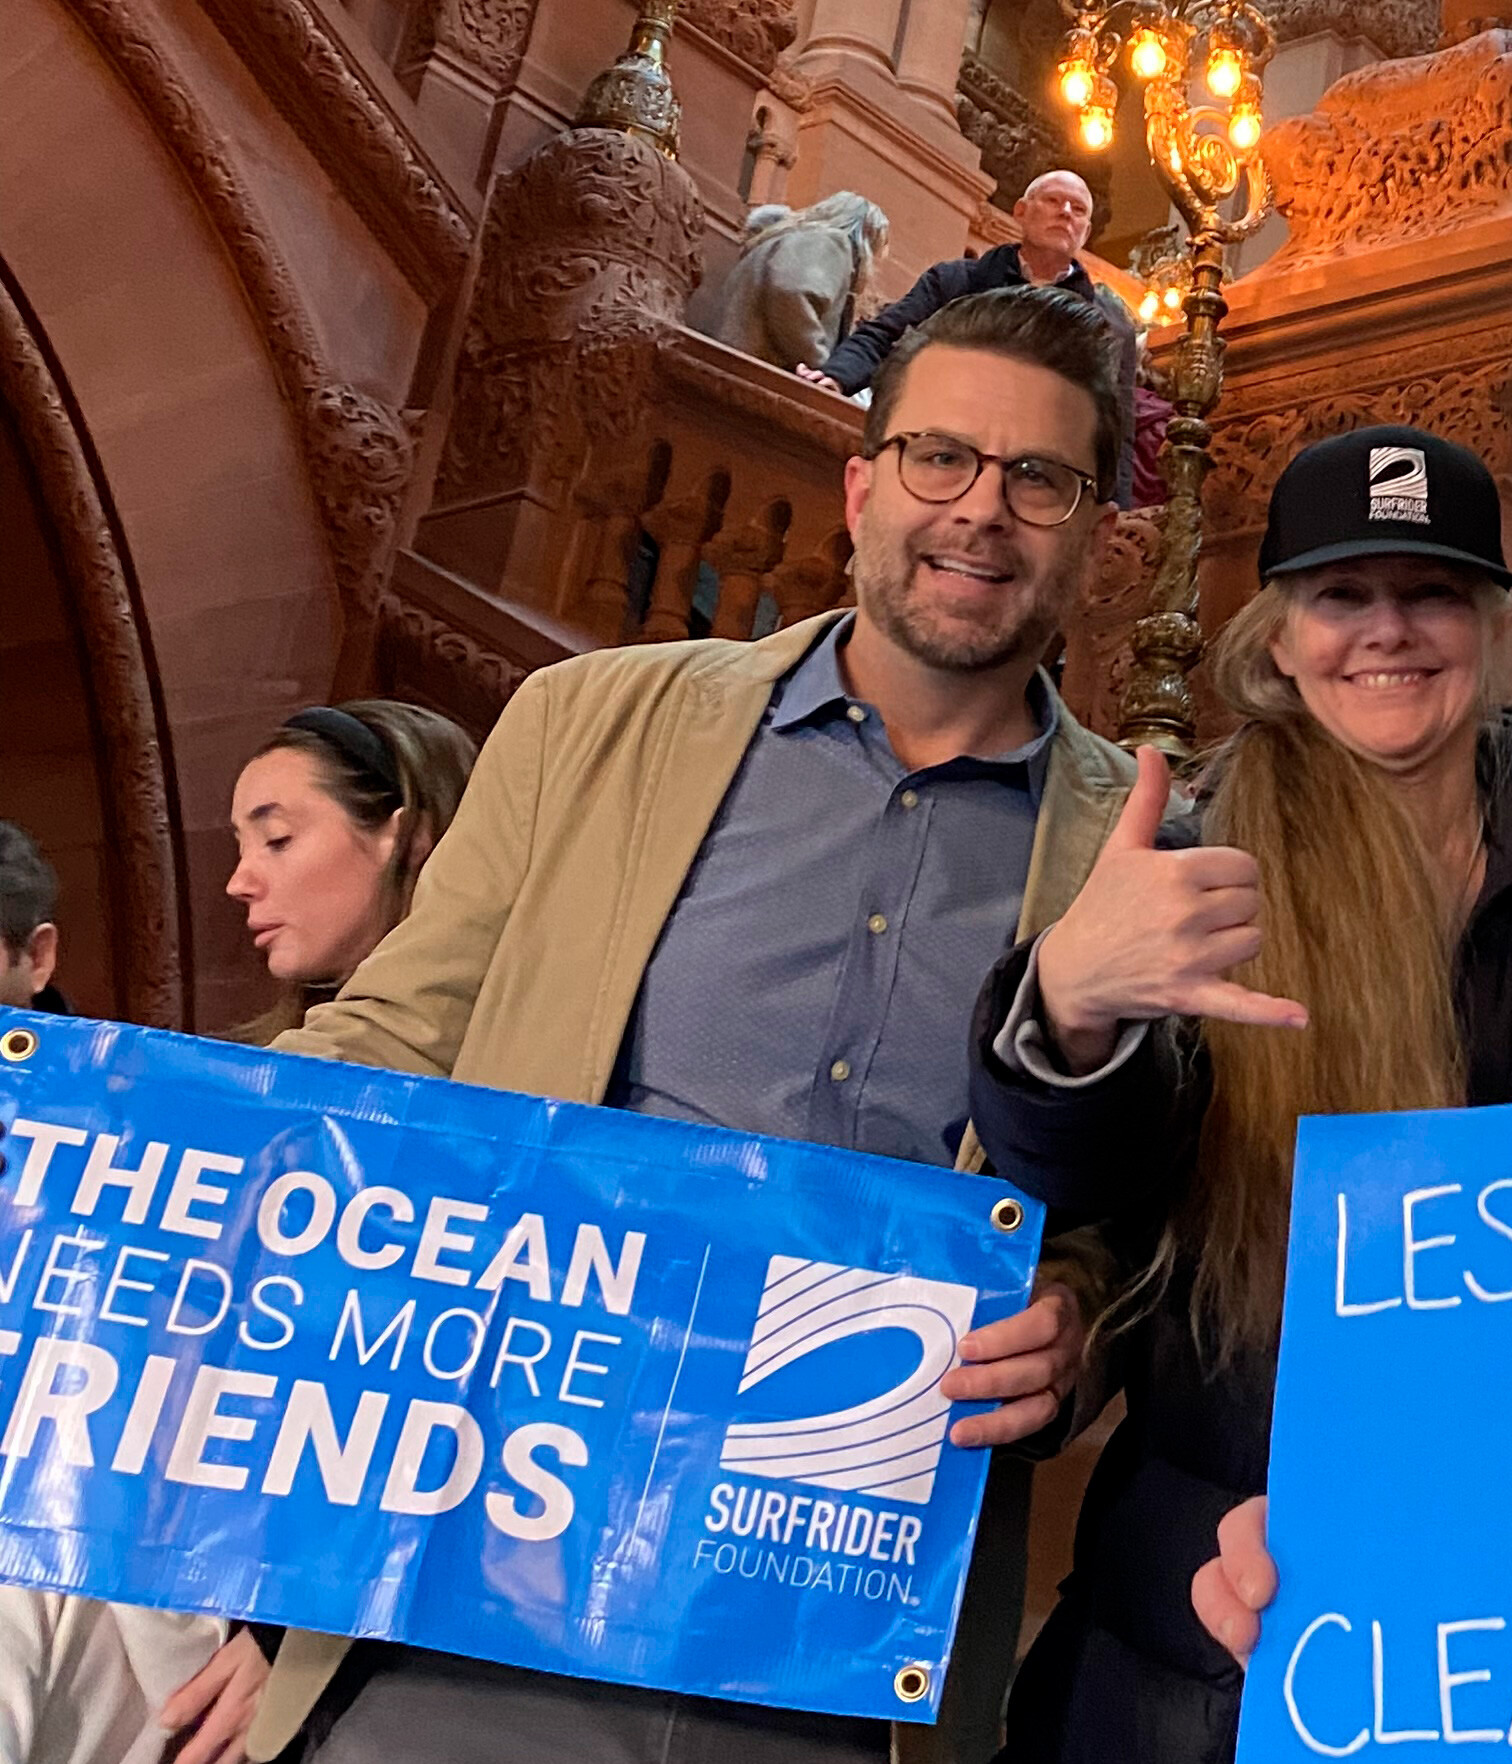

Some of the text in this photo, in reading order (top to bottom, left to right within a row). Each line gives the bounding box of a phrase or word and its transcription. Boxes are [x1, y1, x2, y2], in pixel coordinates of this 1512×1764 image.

[1370, 497, 1427, 513] SURFRIDER
[10, 1118, 647, 1316] THE OCEAN
[328, 1289, 622, 1407] MORE
[0, 1330, 589, 1541] RIENDS
[693, 1539, 915, 1604] FOUNDATION
[705, 1483, 922, 1565] SURFRIDER
